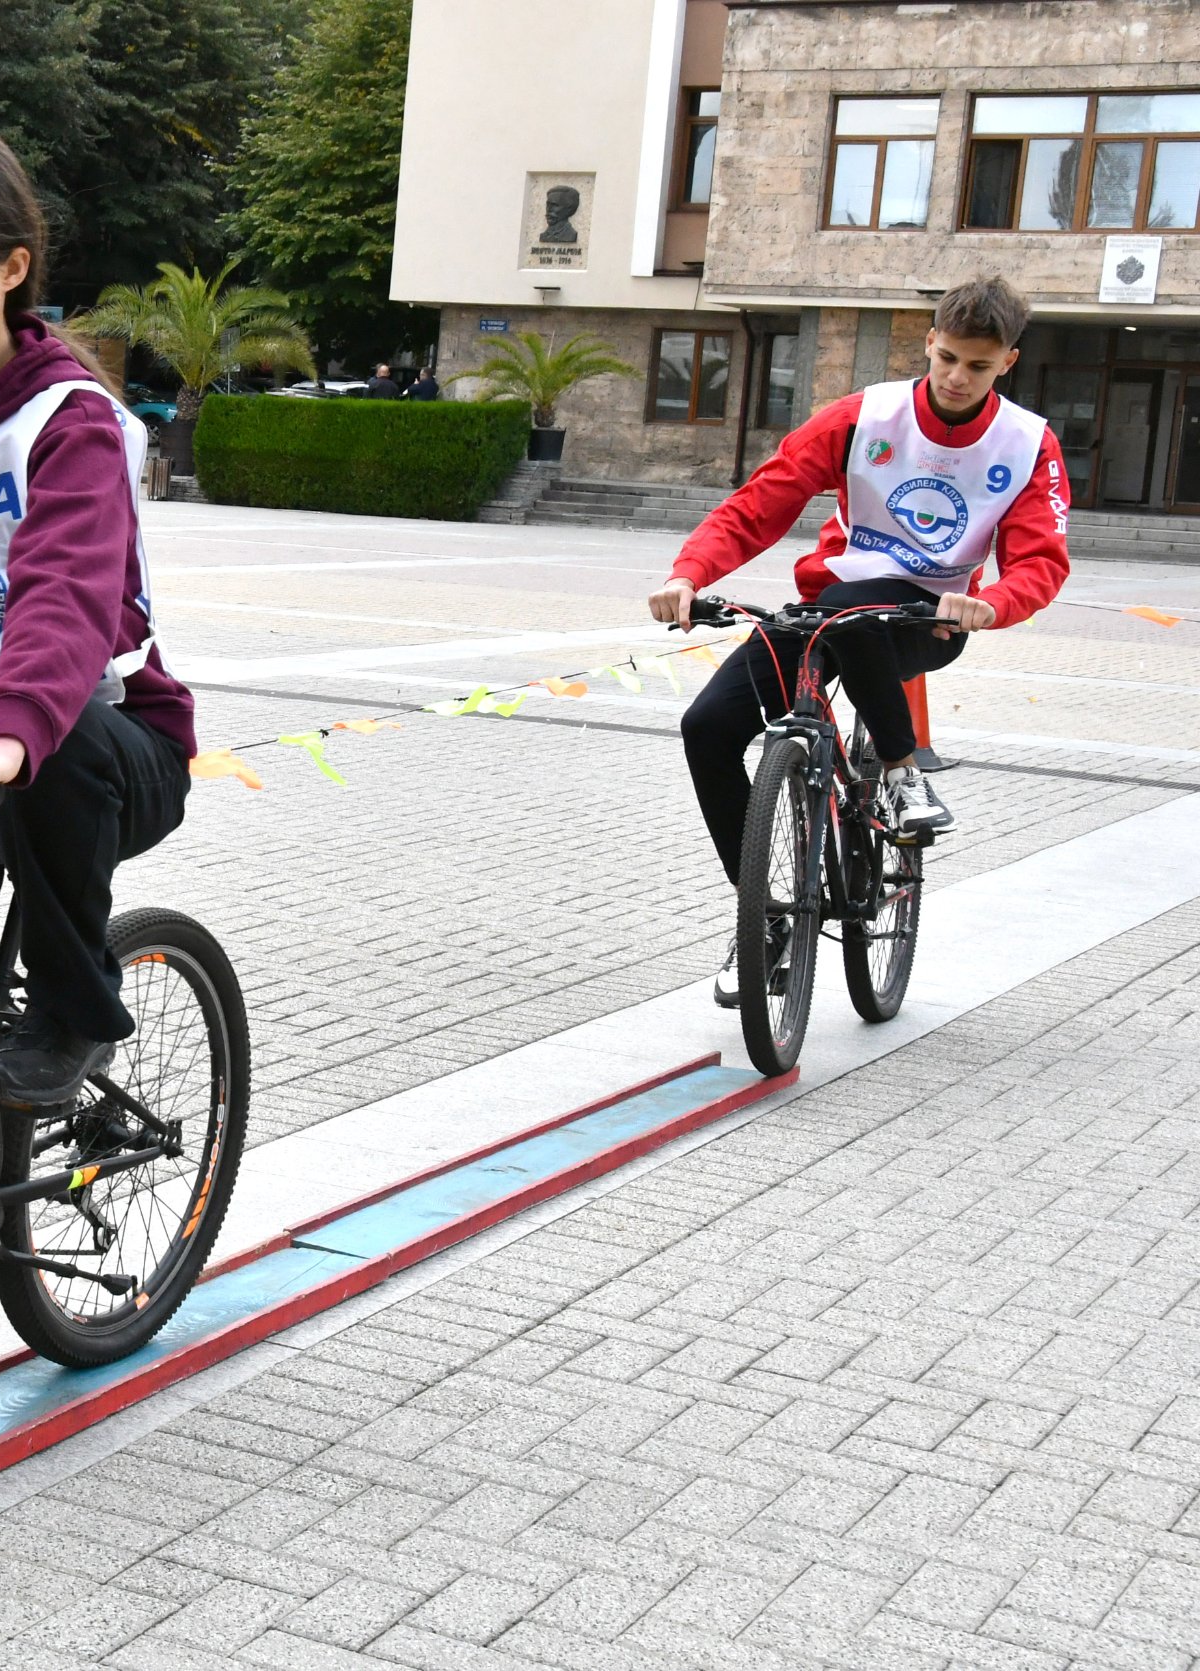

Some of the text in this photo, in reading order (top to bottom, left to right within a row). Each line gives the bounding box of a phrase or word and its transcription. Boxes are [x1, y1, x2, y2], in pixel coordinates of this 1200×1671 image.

[986, 464, 1012, 493] 9
[1048, 460, 1068, 535] GIVOVA
[887, 479, 967, 544] ОМОБИЛЕН КЛУБ СЕВЕР
